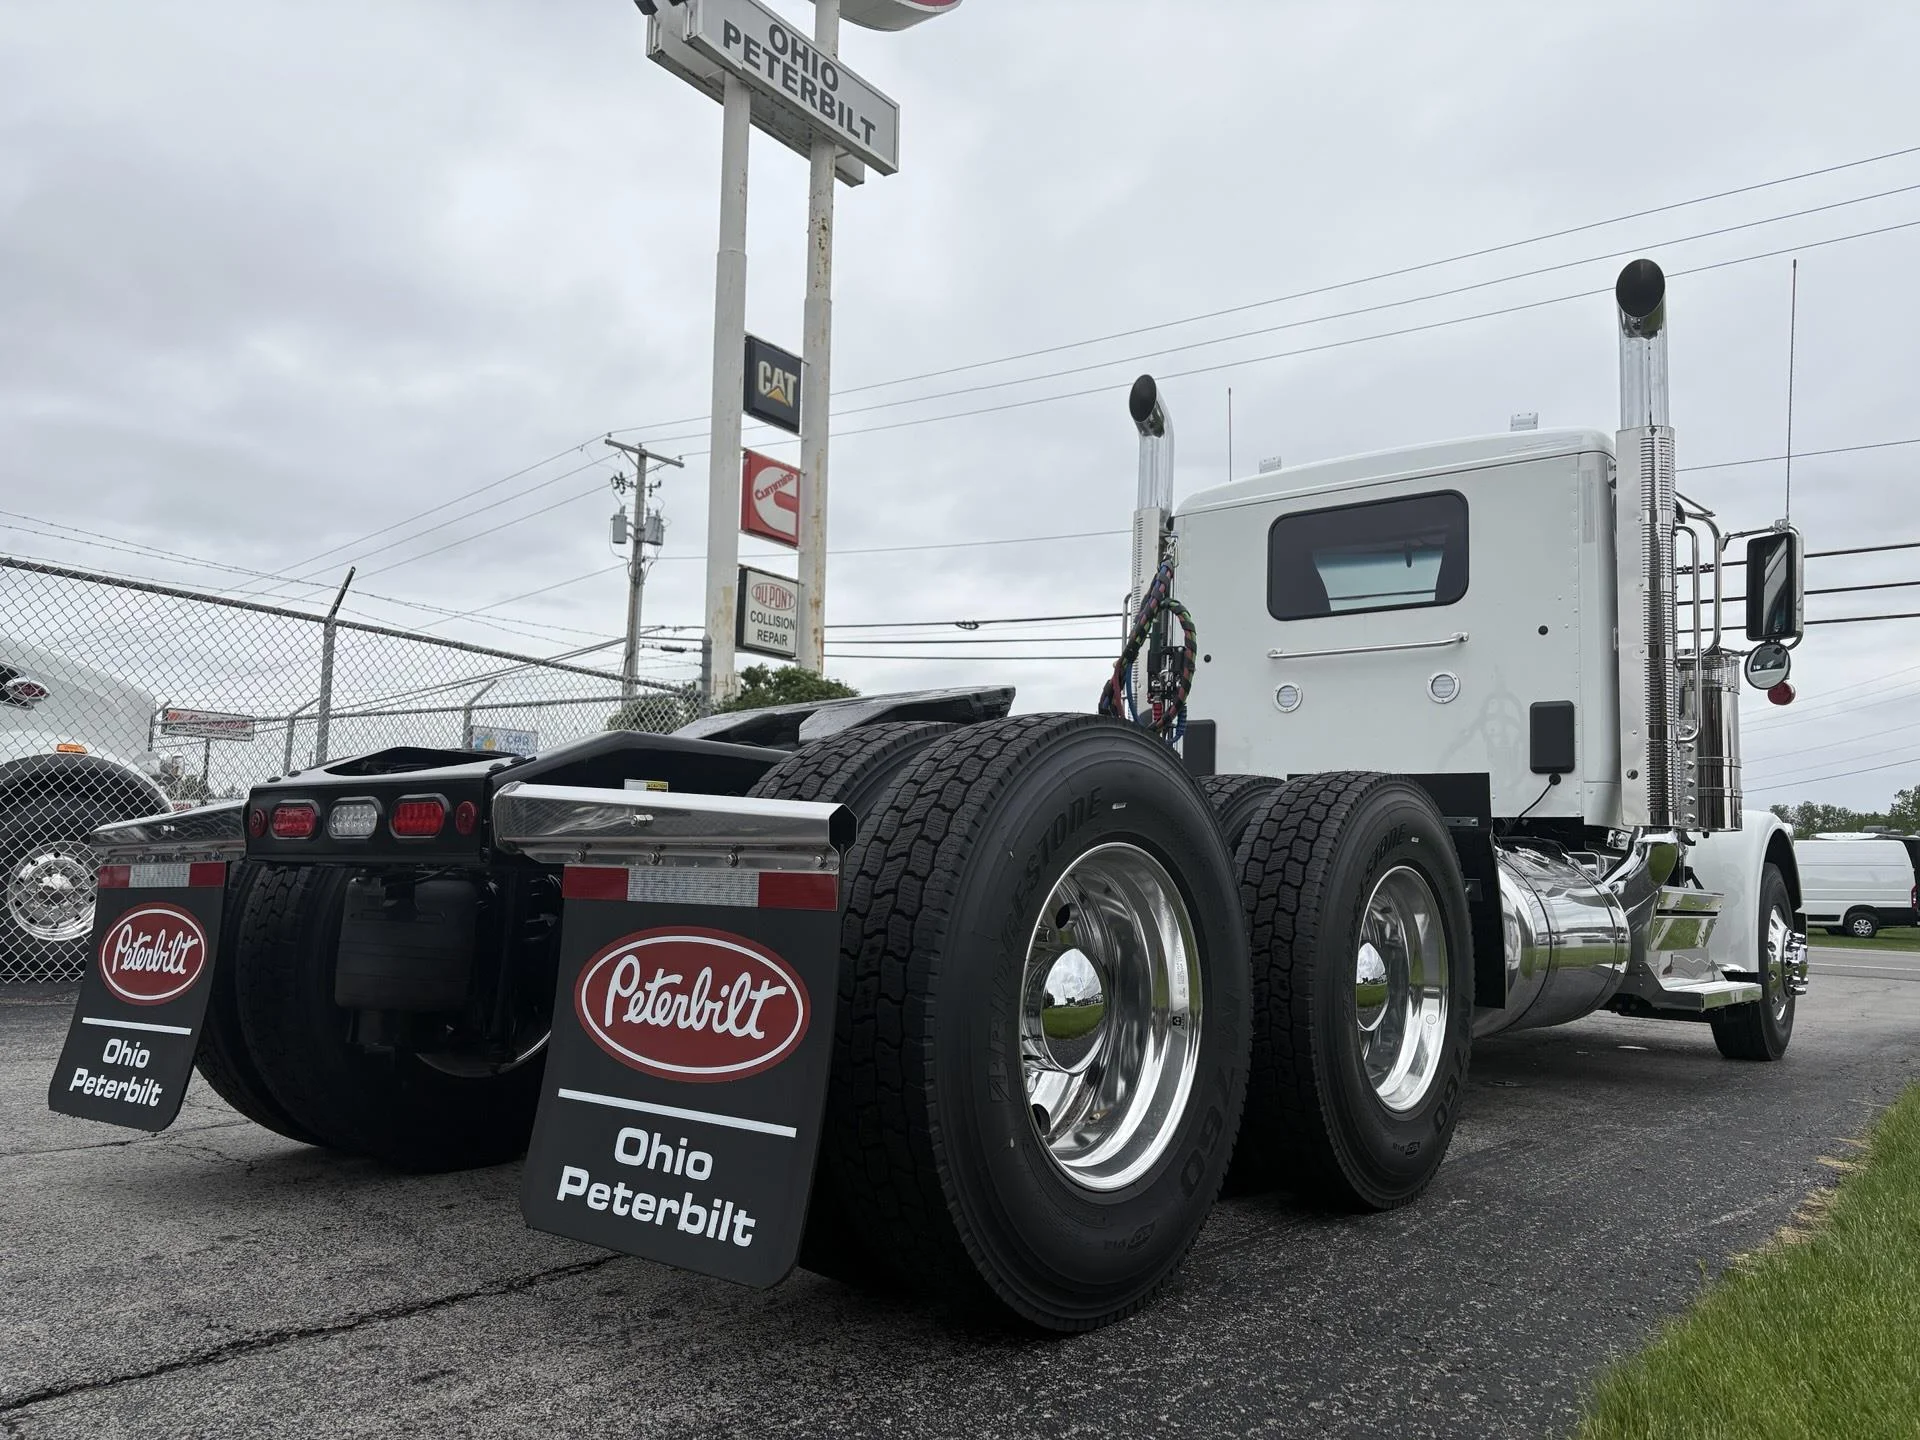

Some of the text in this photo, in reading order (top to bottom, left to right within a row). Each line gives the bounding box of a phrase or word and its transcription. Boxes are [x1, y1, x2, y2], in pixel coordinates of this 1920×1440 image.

[768, 23, 839, 92] OHIO
[723, 19, 877, 147] PETERBILT
[757, 359, 797, 408] CAT
[754, 472, 794, 501] Cummins
[750, 610, 796, 631] COLLISION
[756, 629, 788, 647] REPAIR
[112, 923, 199, 975] Peterbilt
[603, 953, 787, 1041] Peterbilt
[102, 1038, 150, 1069] Ohio
[69, 1067, 163, 1107] Peterbilt
[613, 1126, 713, 1181] Ohio
[556, 1164, 756, 1248] Peterbilt
